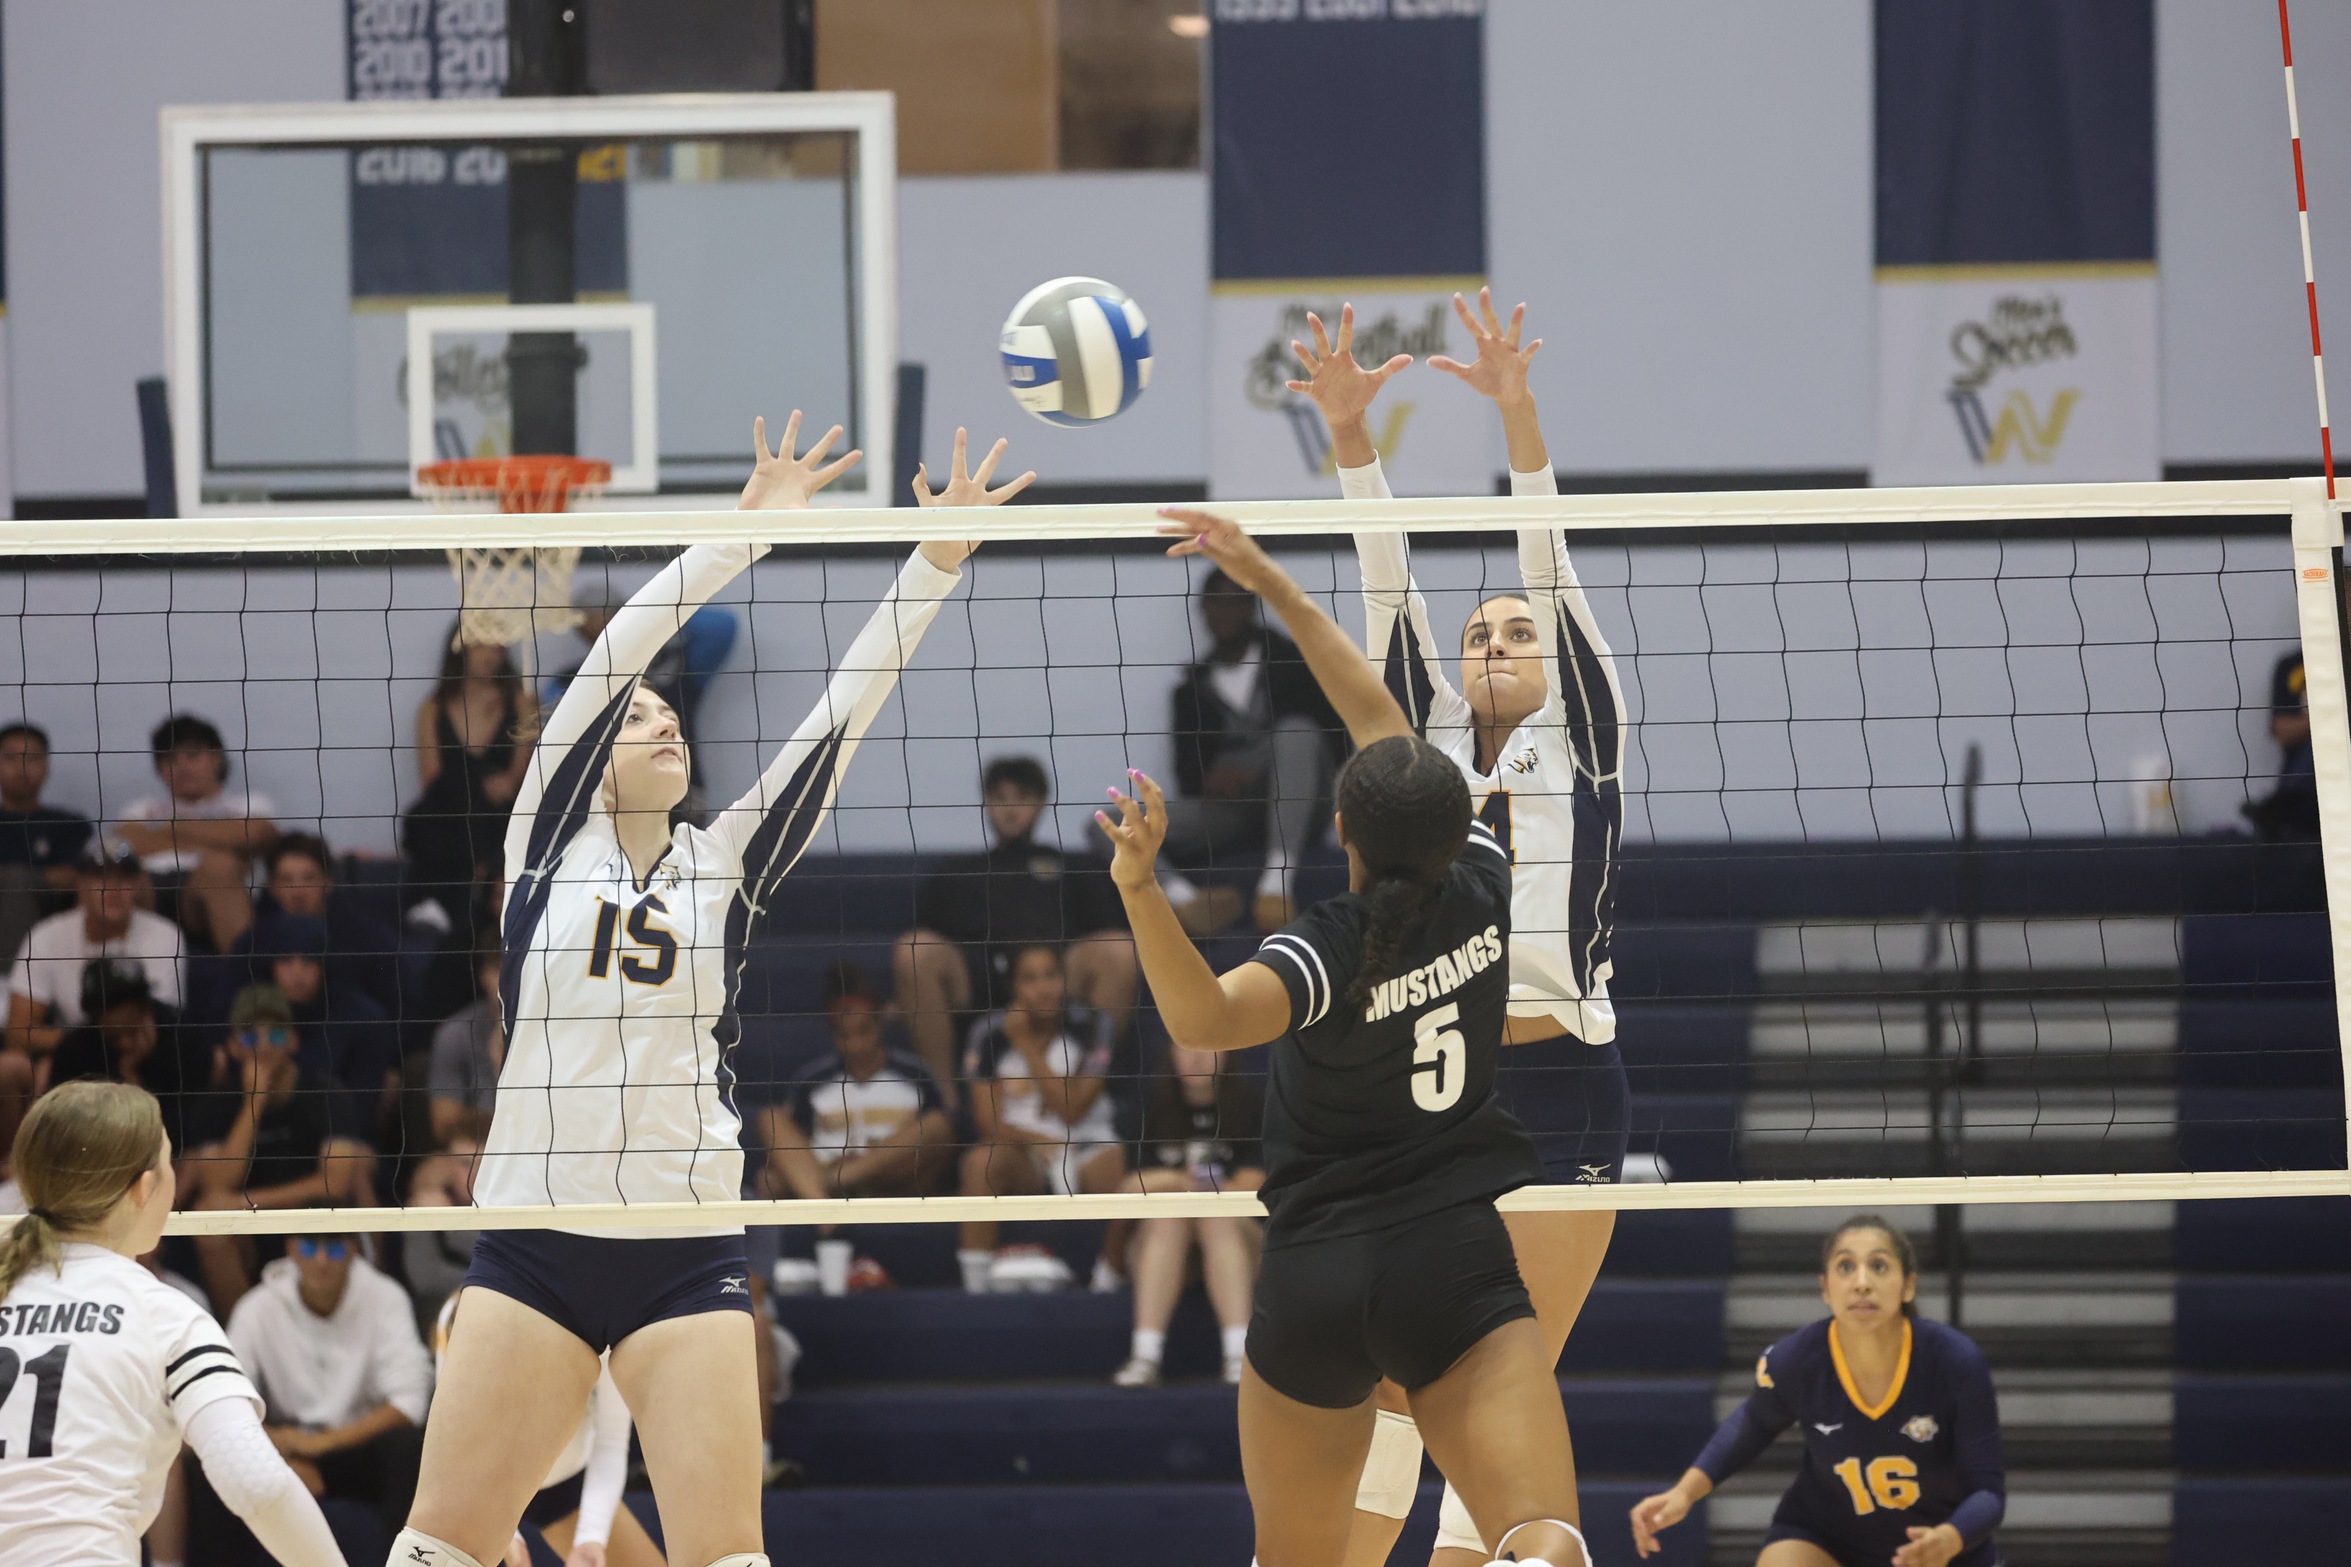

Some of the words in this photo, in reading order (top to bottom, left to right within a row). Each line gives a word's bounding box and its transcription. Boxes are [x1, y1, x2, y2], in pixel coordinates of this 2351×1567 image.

[437, 0, 507, 36] 200
[437, 36, 508, 82] 201
[586, 893, 678, 988] 15
[1365, 924, 1502, 1023] MUSTANGS
[1411, 1002, 1466, 1112] 5
[1833, 1455, 1921, 1515] 16
